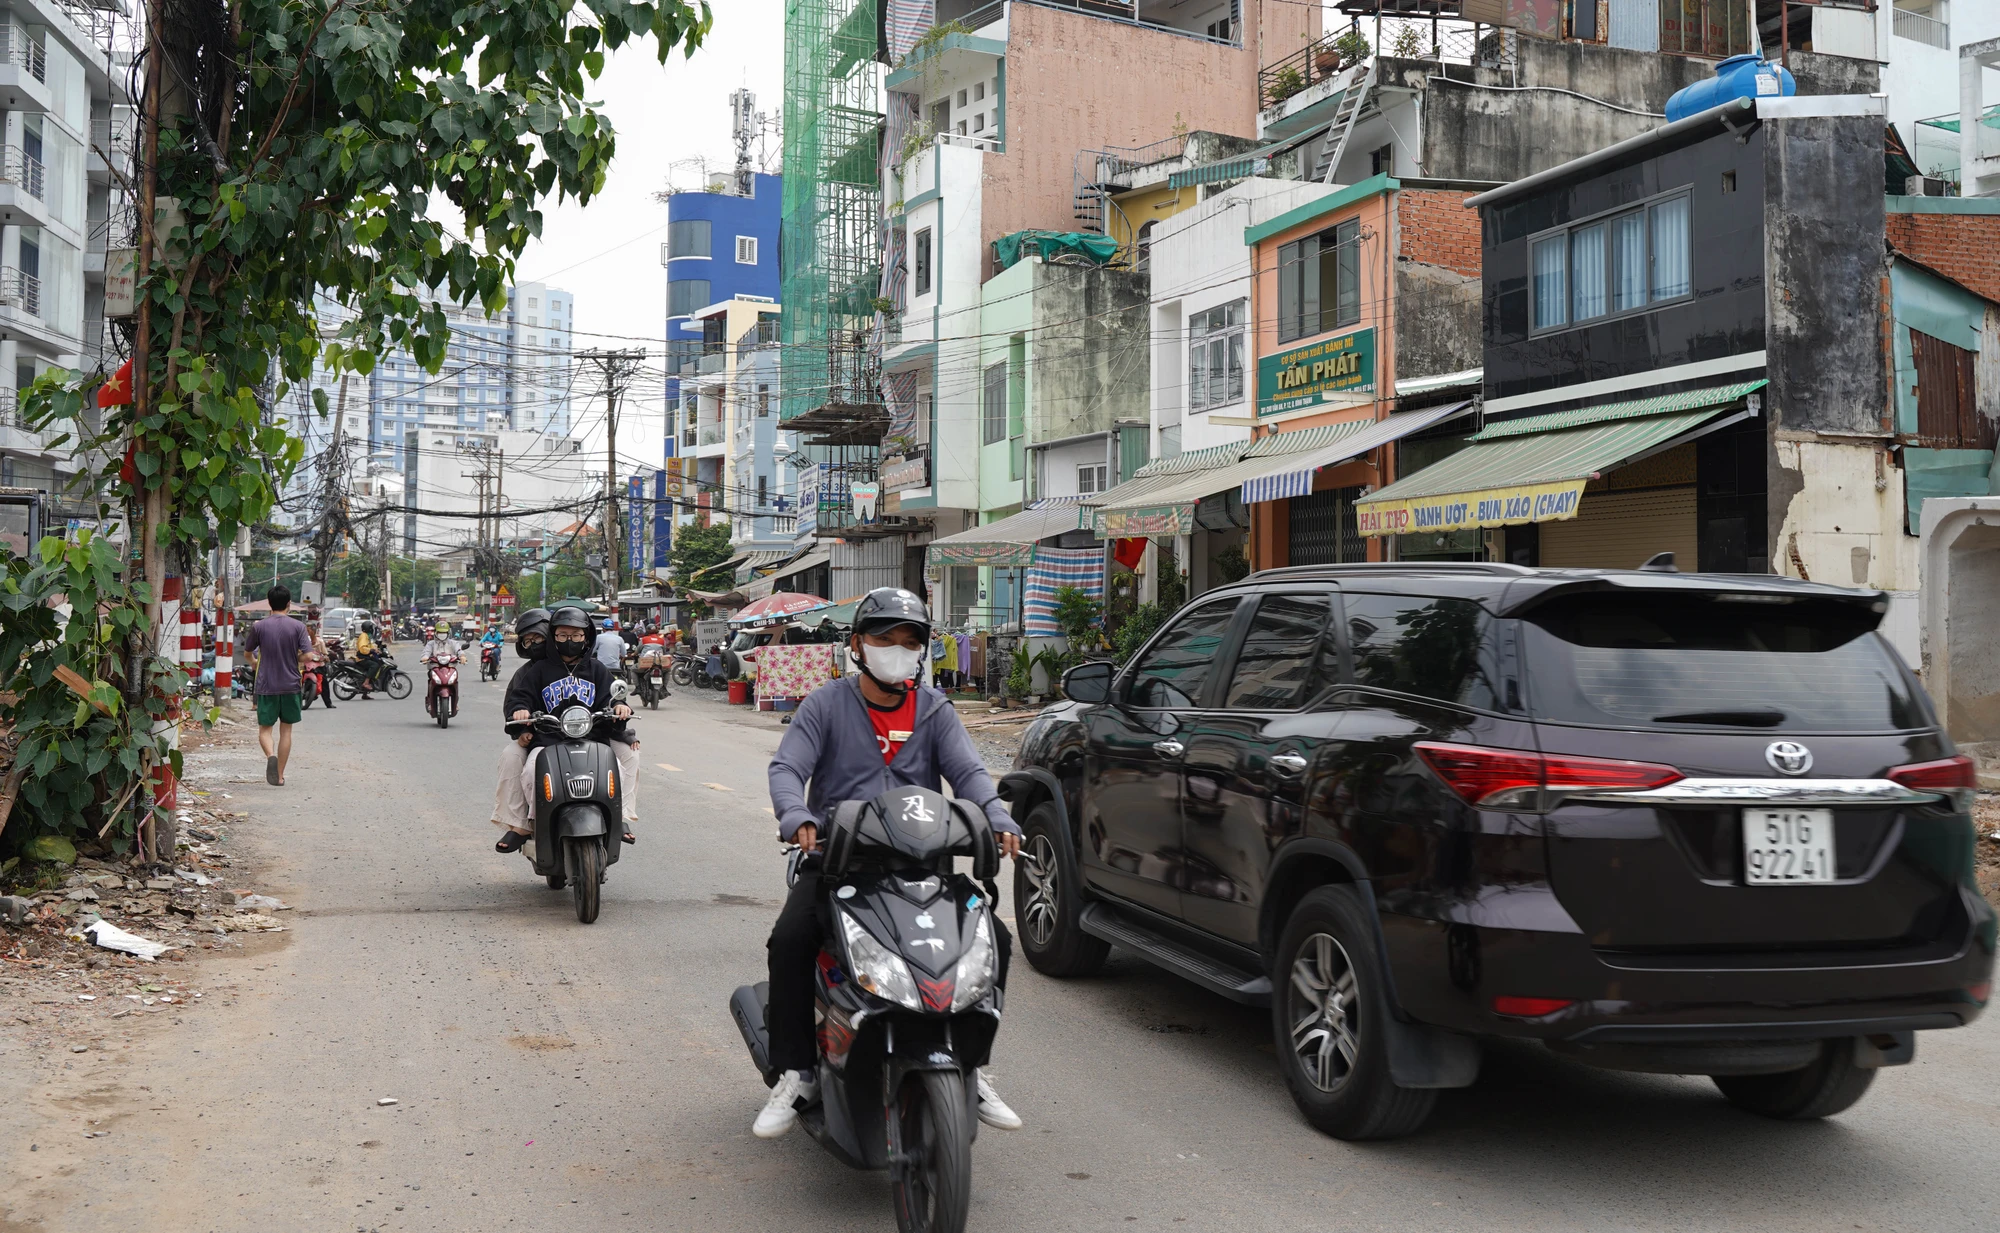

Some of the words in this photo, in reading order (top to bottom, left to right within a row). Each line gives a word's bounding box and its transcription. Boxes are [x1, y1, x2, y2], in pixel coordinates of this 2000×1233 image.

[1325, 340, 1343, 354] BÁNH
[1276, 361, 1311, 390] TẤN
[1360, 505, 1382, 531] HẢI
[1385, 508, 1409, 533] THỌ
[1413, 503, 1442, 528] BÁNH
[1477, 495, 1501, 522] BÚN
[1503, 493, 1531, 520] XÀO
[1532, 489, 1578, 523] (CHAY)
[753, 618, 776, 628] CHIN-SU
[1765, 813, 1812, 845] 51G
[1749, 848, 1829, 880] 92241
